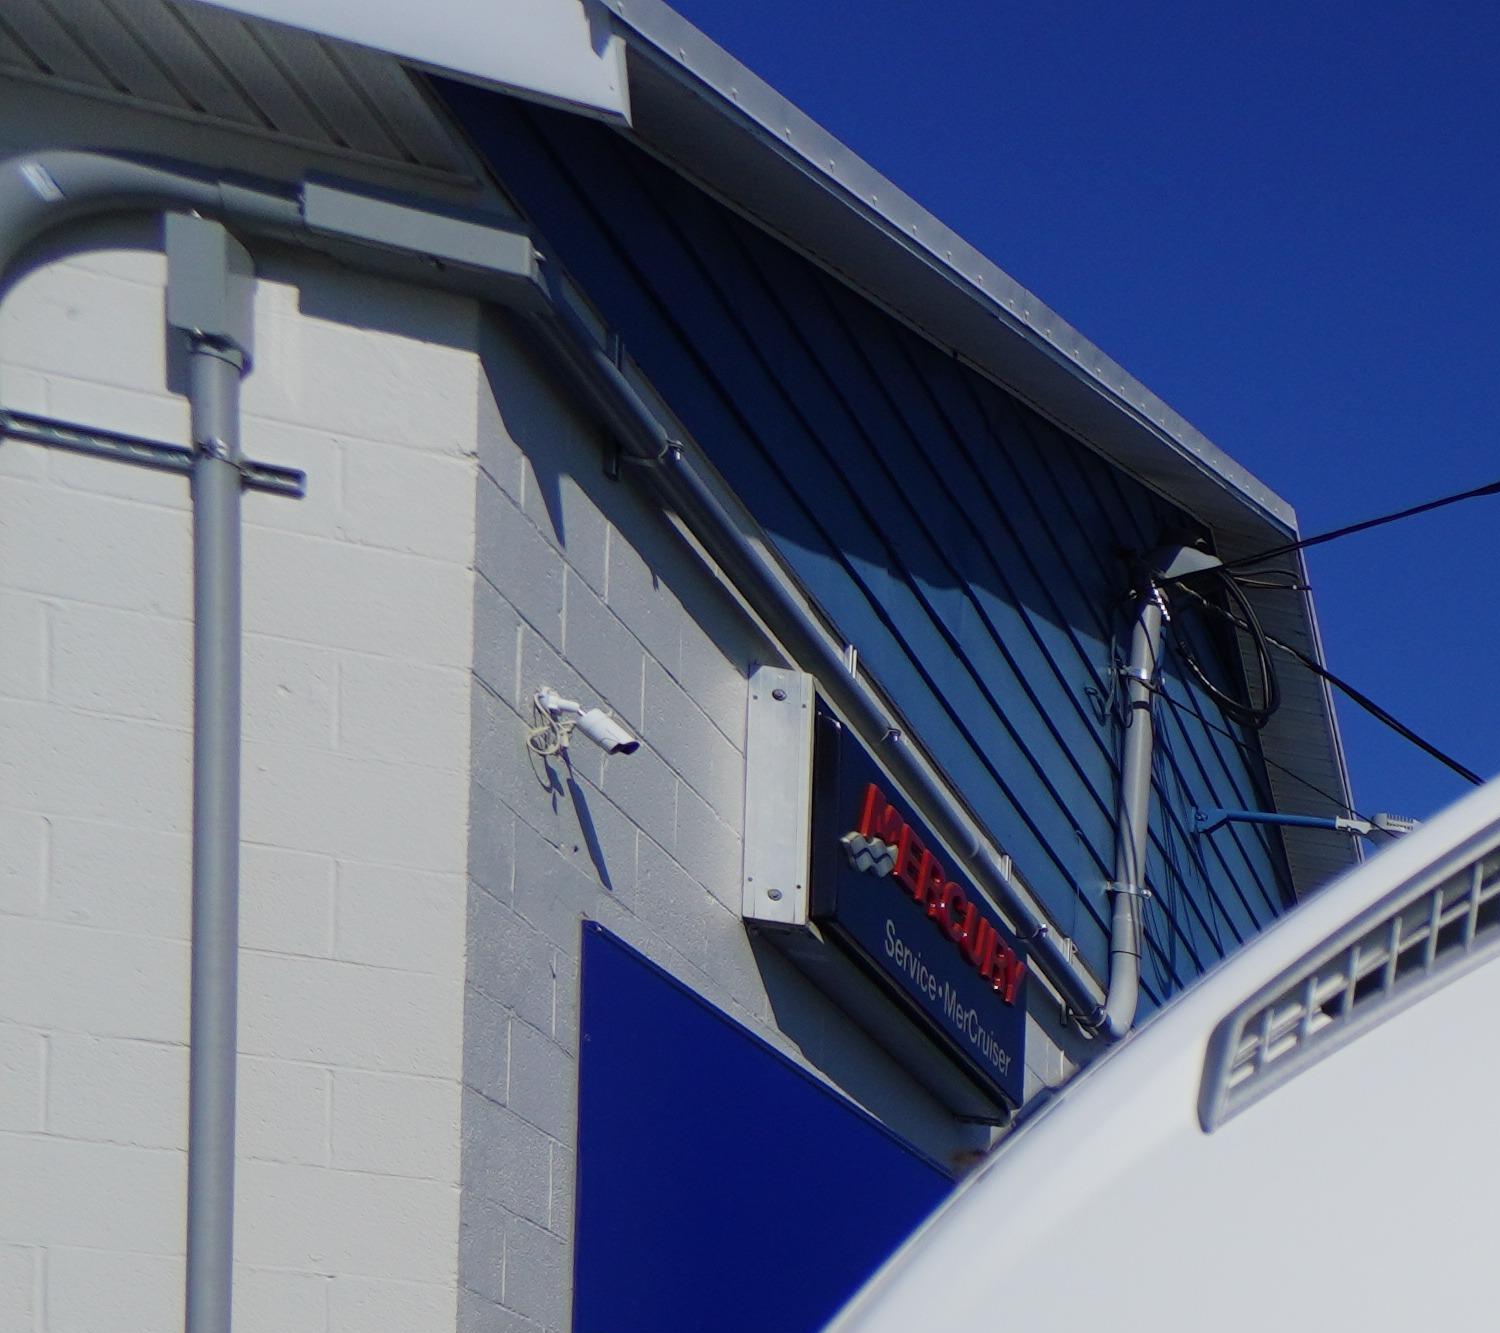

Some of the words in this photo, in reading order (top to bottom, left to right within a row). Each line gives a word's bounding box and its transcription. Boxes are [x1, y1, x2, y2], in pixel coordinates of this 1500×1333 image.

[858, 782, 1026, 1006] MERCURY
[884, 918, 939, 1002] Service
[942, 986, 1013, 1078] MerCruiser
